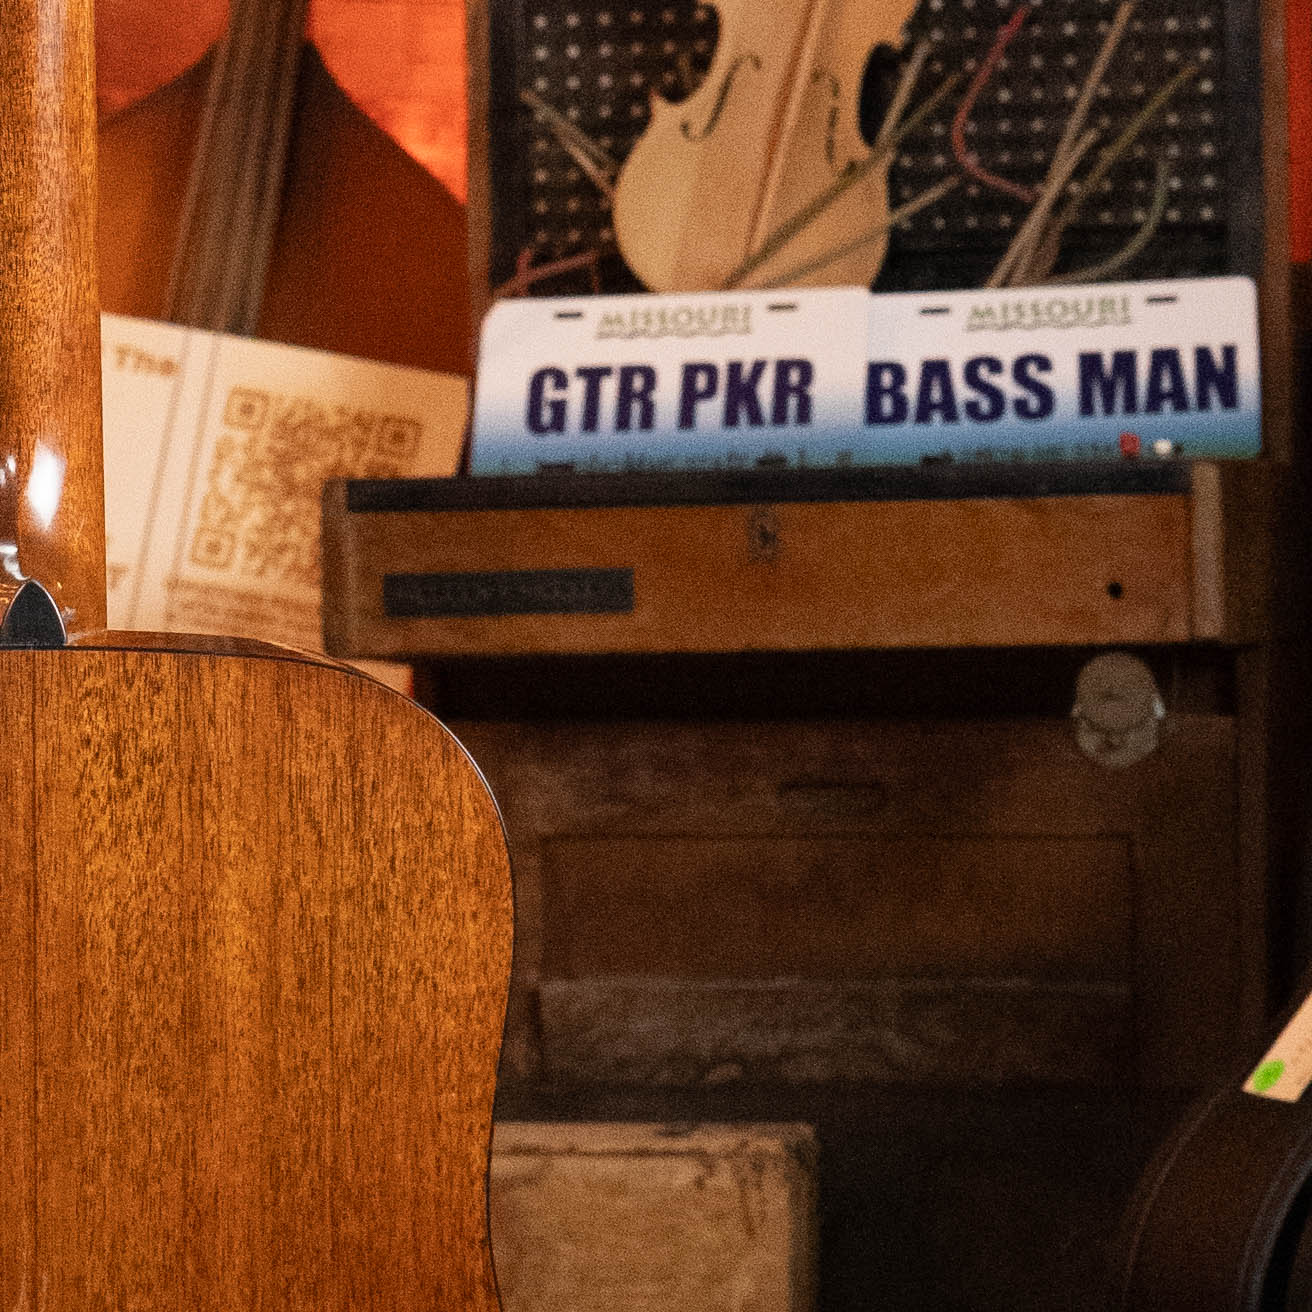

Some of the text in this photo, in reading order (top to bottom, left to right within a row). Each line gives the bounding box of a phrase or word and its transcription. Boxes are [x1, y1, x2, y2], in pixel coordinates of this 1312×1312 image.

[595, 305, 752, 339] MISSOURI
[965, 297, 1131, 331] MISSOURI
[526, 358, 815, 436] GTR PKR
[865, 344, 1239, 426] BASS MAN
